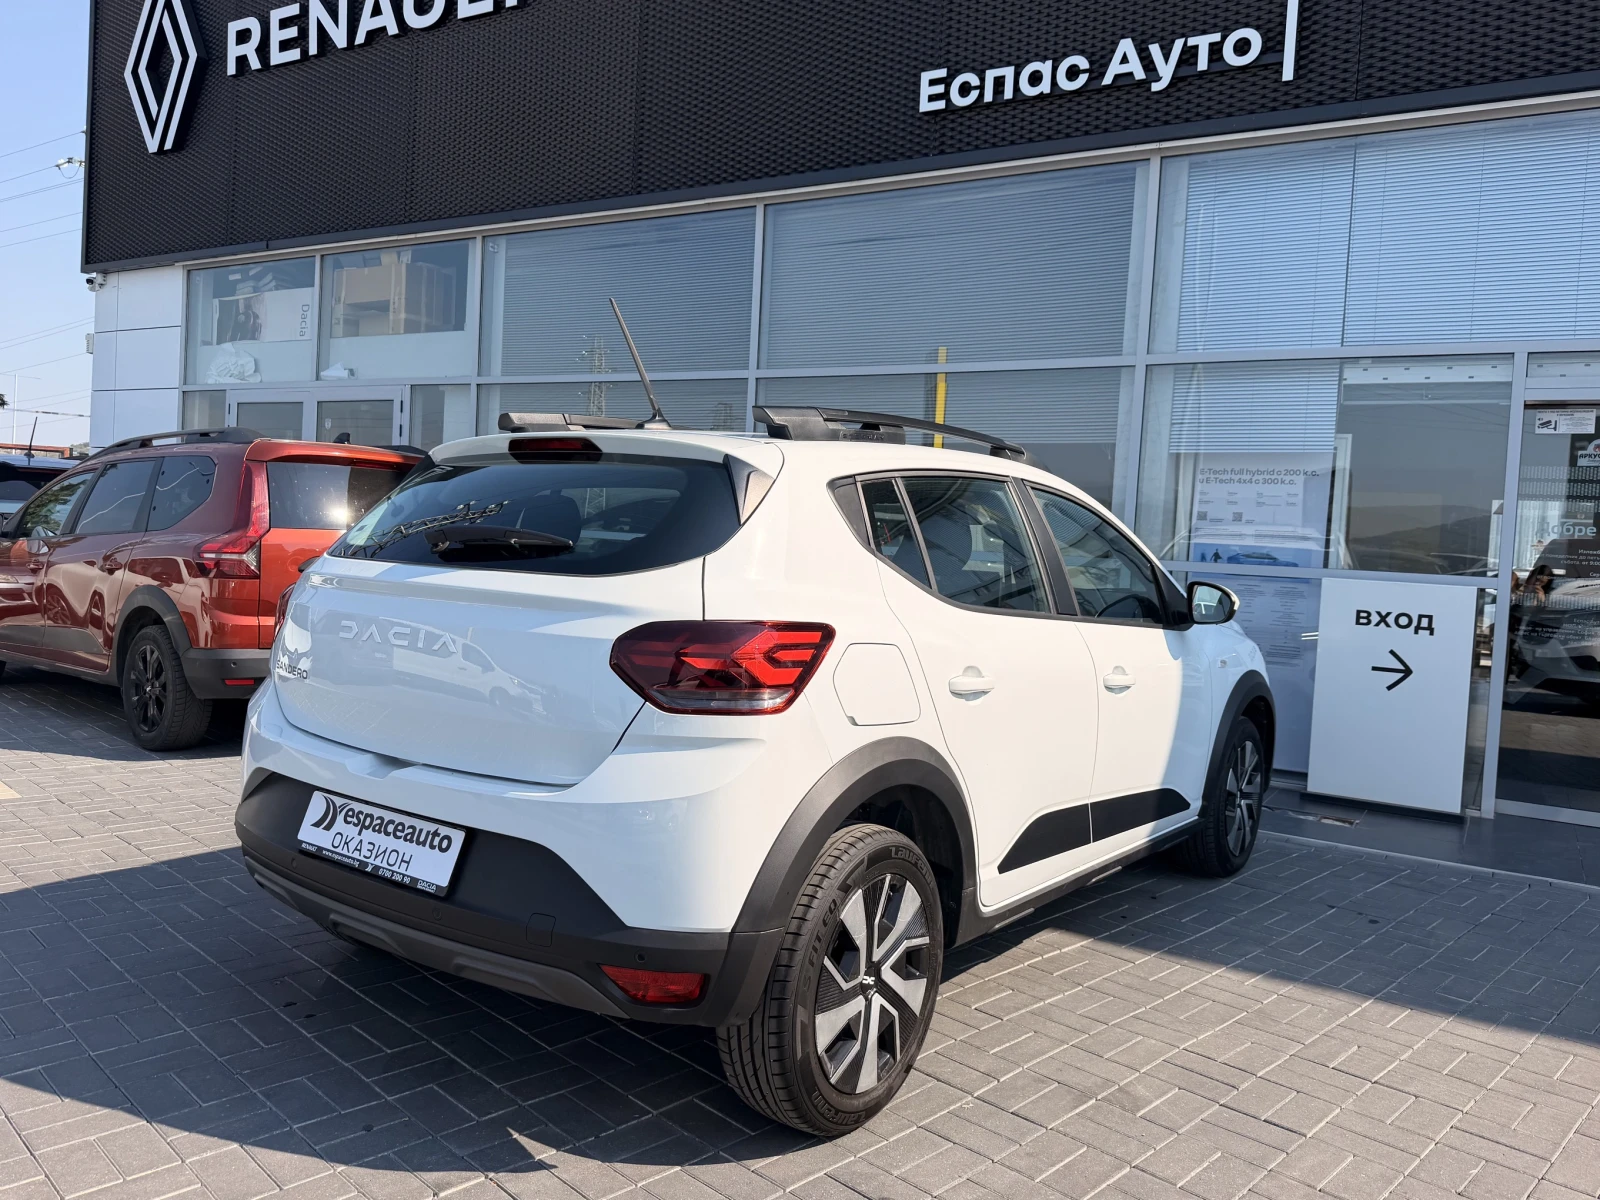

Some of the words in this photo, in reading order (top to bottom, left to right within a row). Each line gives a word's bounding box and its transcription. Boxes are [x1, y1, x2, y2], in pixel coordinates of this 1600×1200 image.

[227, 0, 518, 76] RENA
[919, 54, 1090, 113] Еспас
[1101, 27, 1263, 92] Ауто
[299, 303, 310, 338] Dacia
[1199, 468, 1229, 476] E-Tech
[1230, 468, 1245, 476] full
[1245, 468, 1275, 477] hybrid
[1283, 469, 1301, 477] 200
[1205, 477, 1235, 485] E-Tech
[1261, 478, 1279, 486] 300
[338, 620, 459, 653] DACIA
[276, 659, 309, 680] SANDERO
[343, 806, 453, 854] espaceauto
[331, 831, 413, 872] ОКАЗИОН
